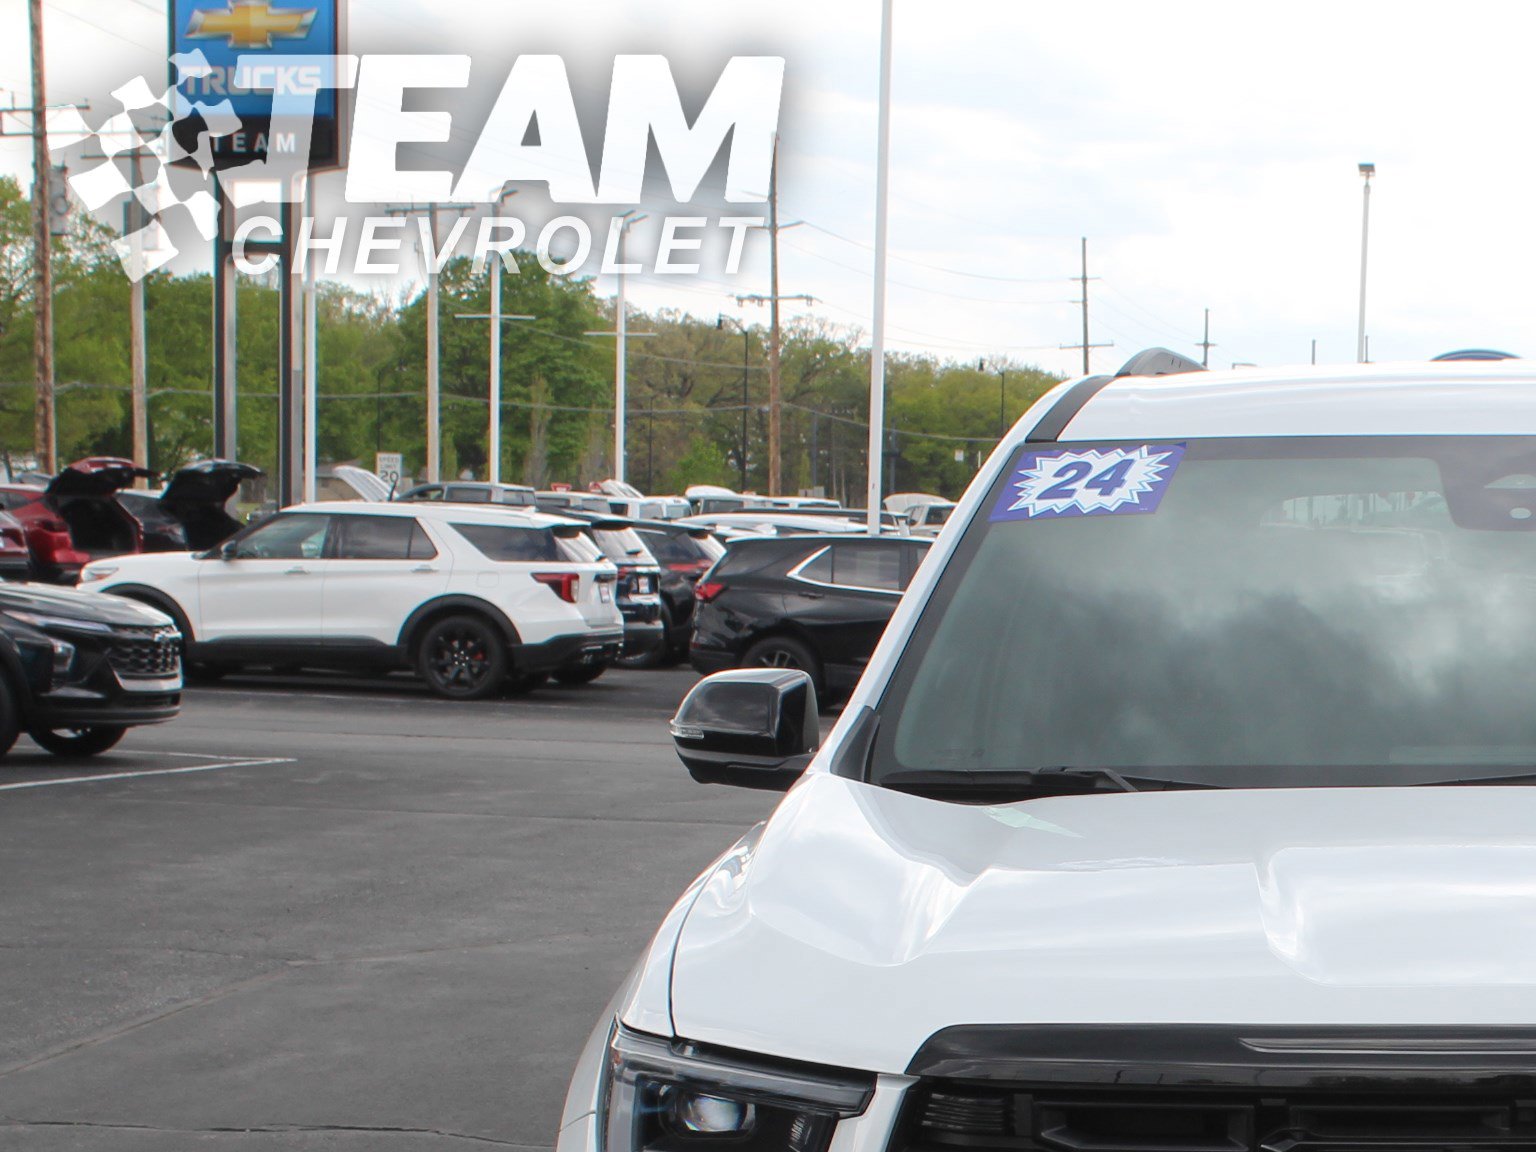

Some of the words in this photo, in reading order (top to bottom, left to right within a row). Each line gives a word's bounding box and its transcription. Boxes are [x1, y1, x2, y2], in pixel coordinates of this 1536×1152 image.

[180, 66, 322, 96] TRUCKS
[211, 132, 296, 153] TEAM
[1036, 458, 1137, 501] 24
